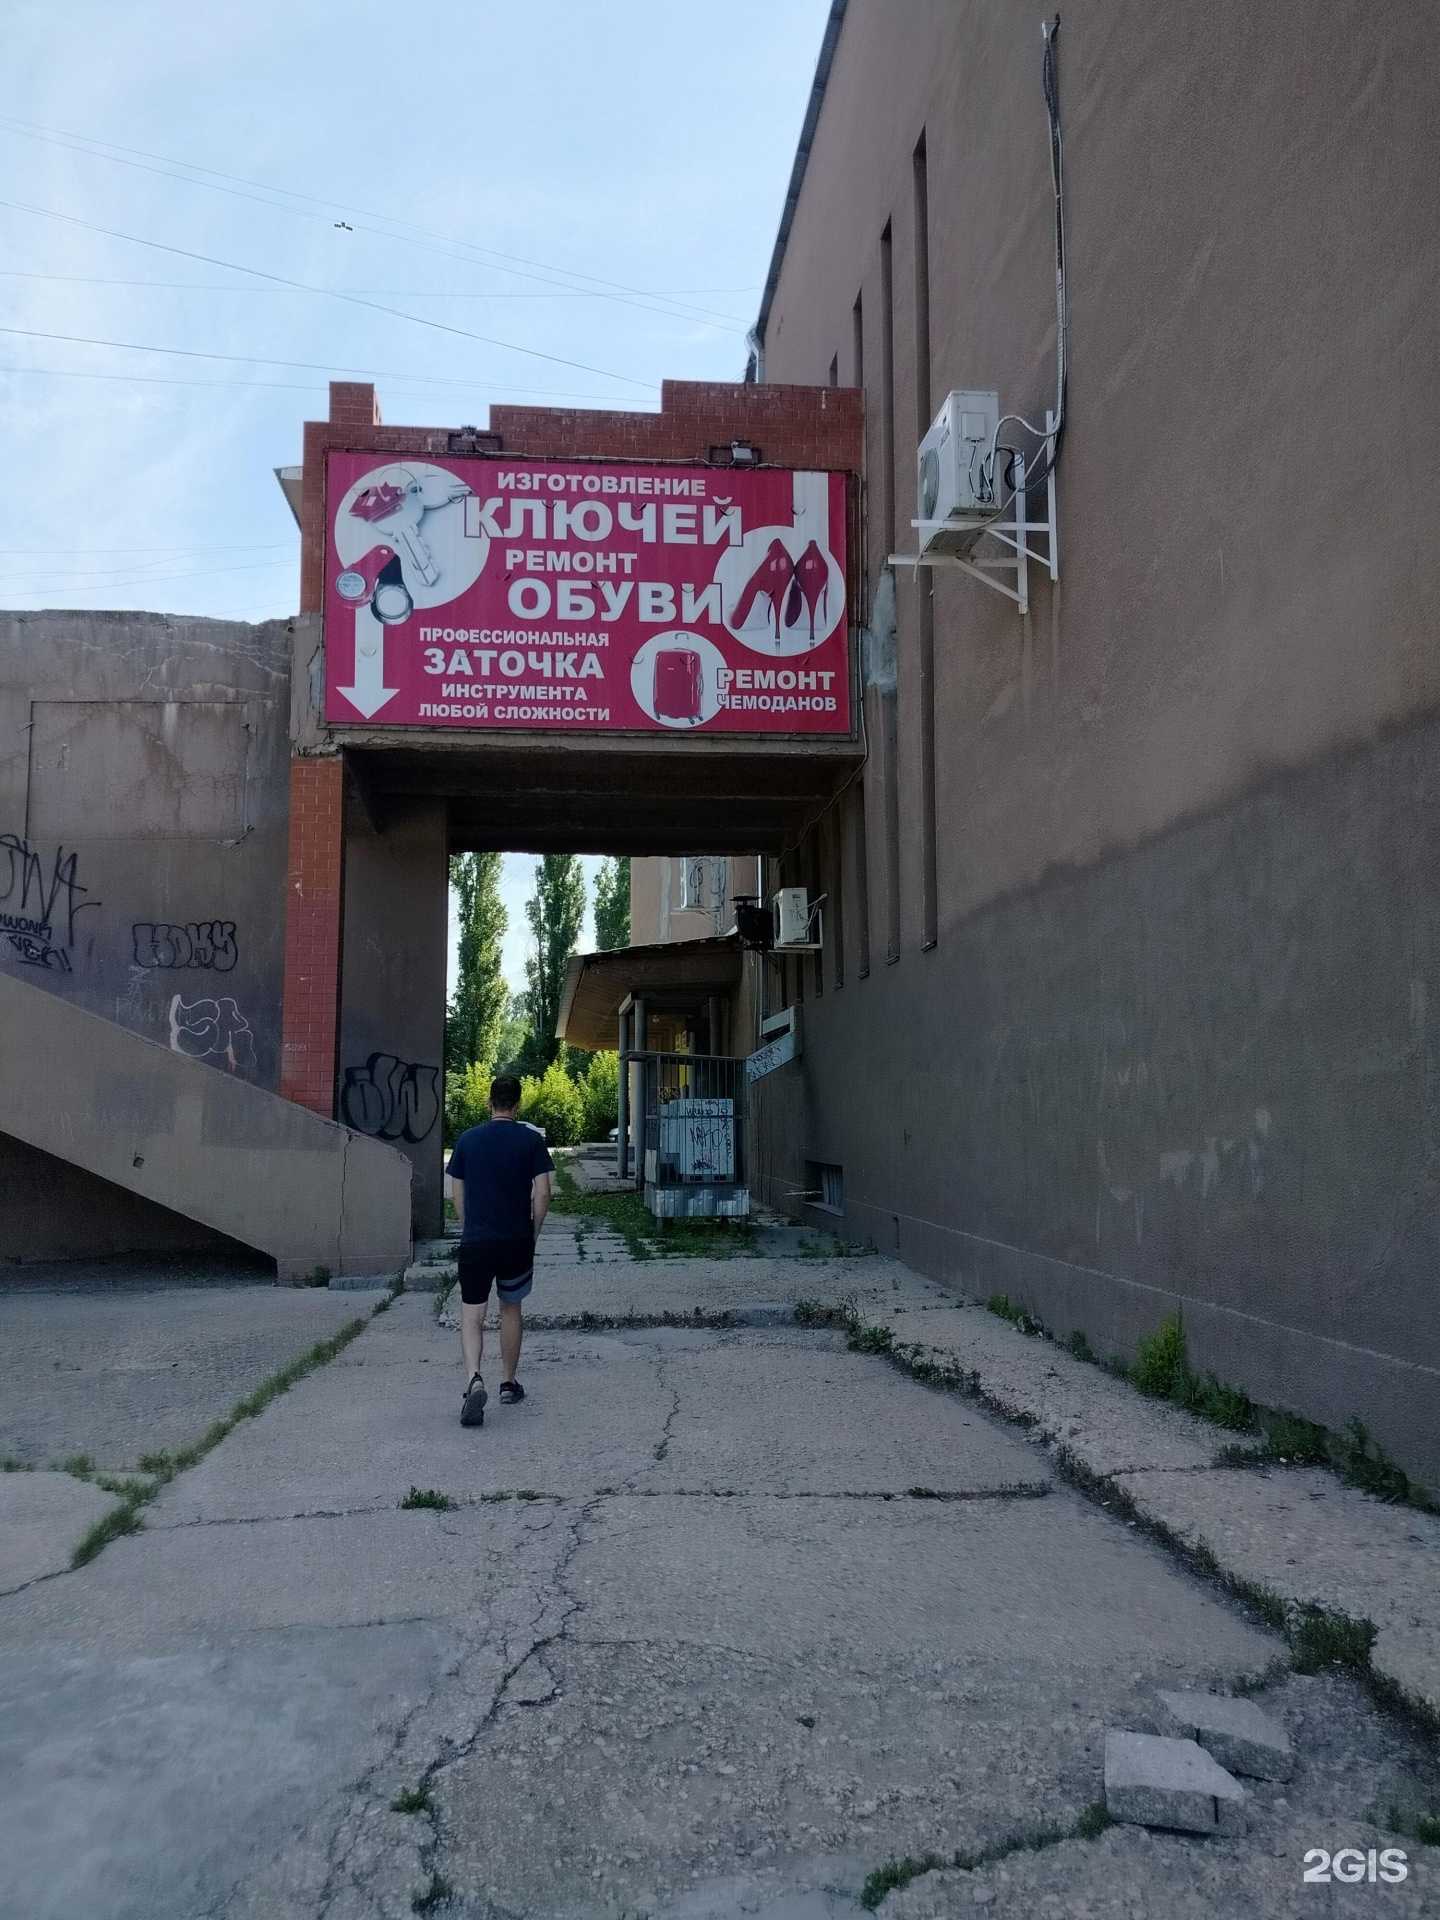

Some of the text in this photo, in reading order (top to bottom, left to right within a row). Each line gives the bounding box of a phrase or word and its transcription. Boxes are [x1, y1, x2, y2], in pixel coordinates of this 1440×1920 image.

[497, 472, 706, 497] ИЗГОТОВЛЕНИЕ
[464, 495, 743, 547] КЛЮЧЕЙ
[505, 549, 638, 574] РЕМОНТ
[507, 577, 723, 625] ОБУВИ
[419, 627, 610, 647] ПРОФЕССИОНАЛЬНАЯ
[423, 647, 605, 680] ЗАТОЧКА
[716, 667, 836, 691] РЕМОНТ
[441, 683, 588, 701] ИНСТРУМЕНТА
[716, 693, 837, 713] ЧЕМОДАНОВ
[418, 703, 610, 721] ЛЮБОЙ СЛОЖНОСТИ
